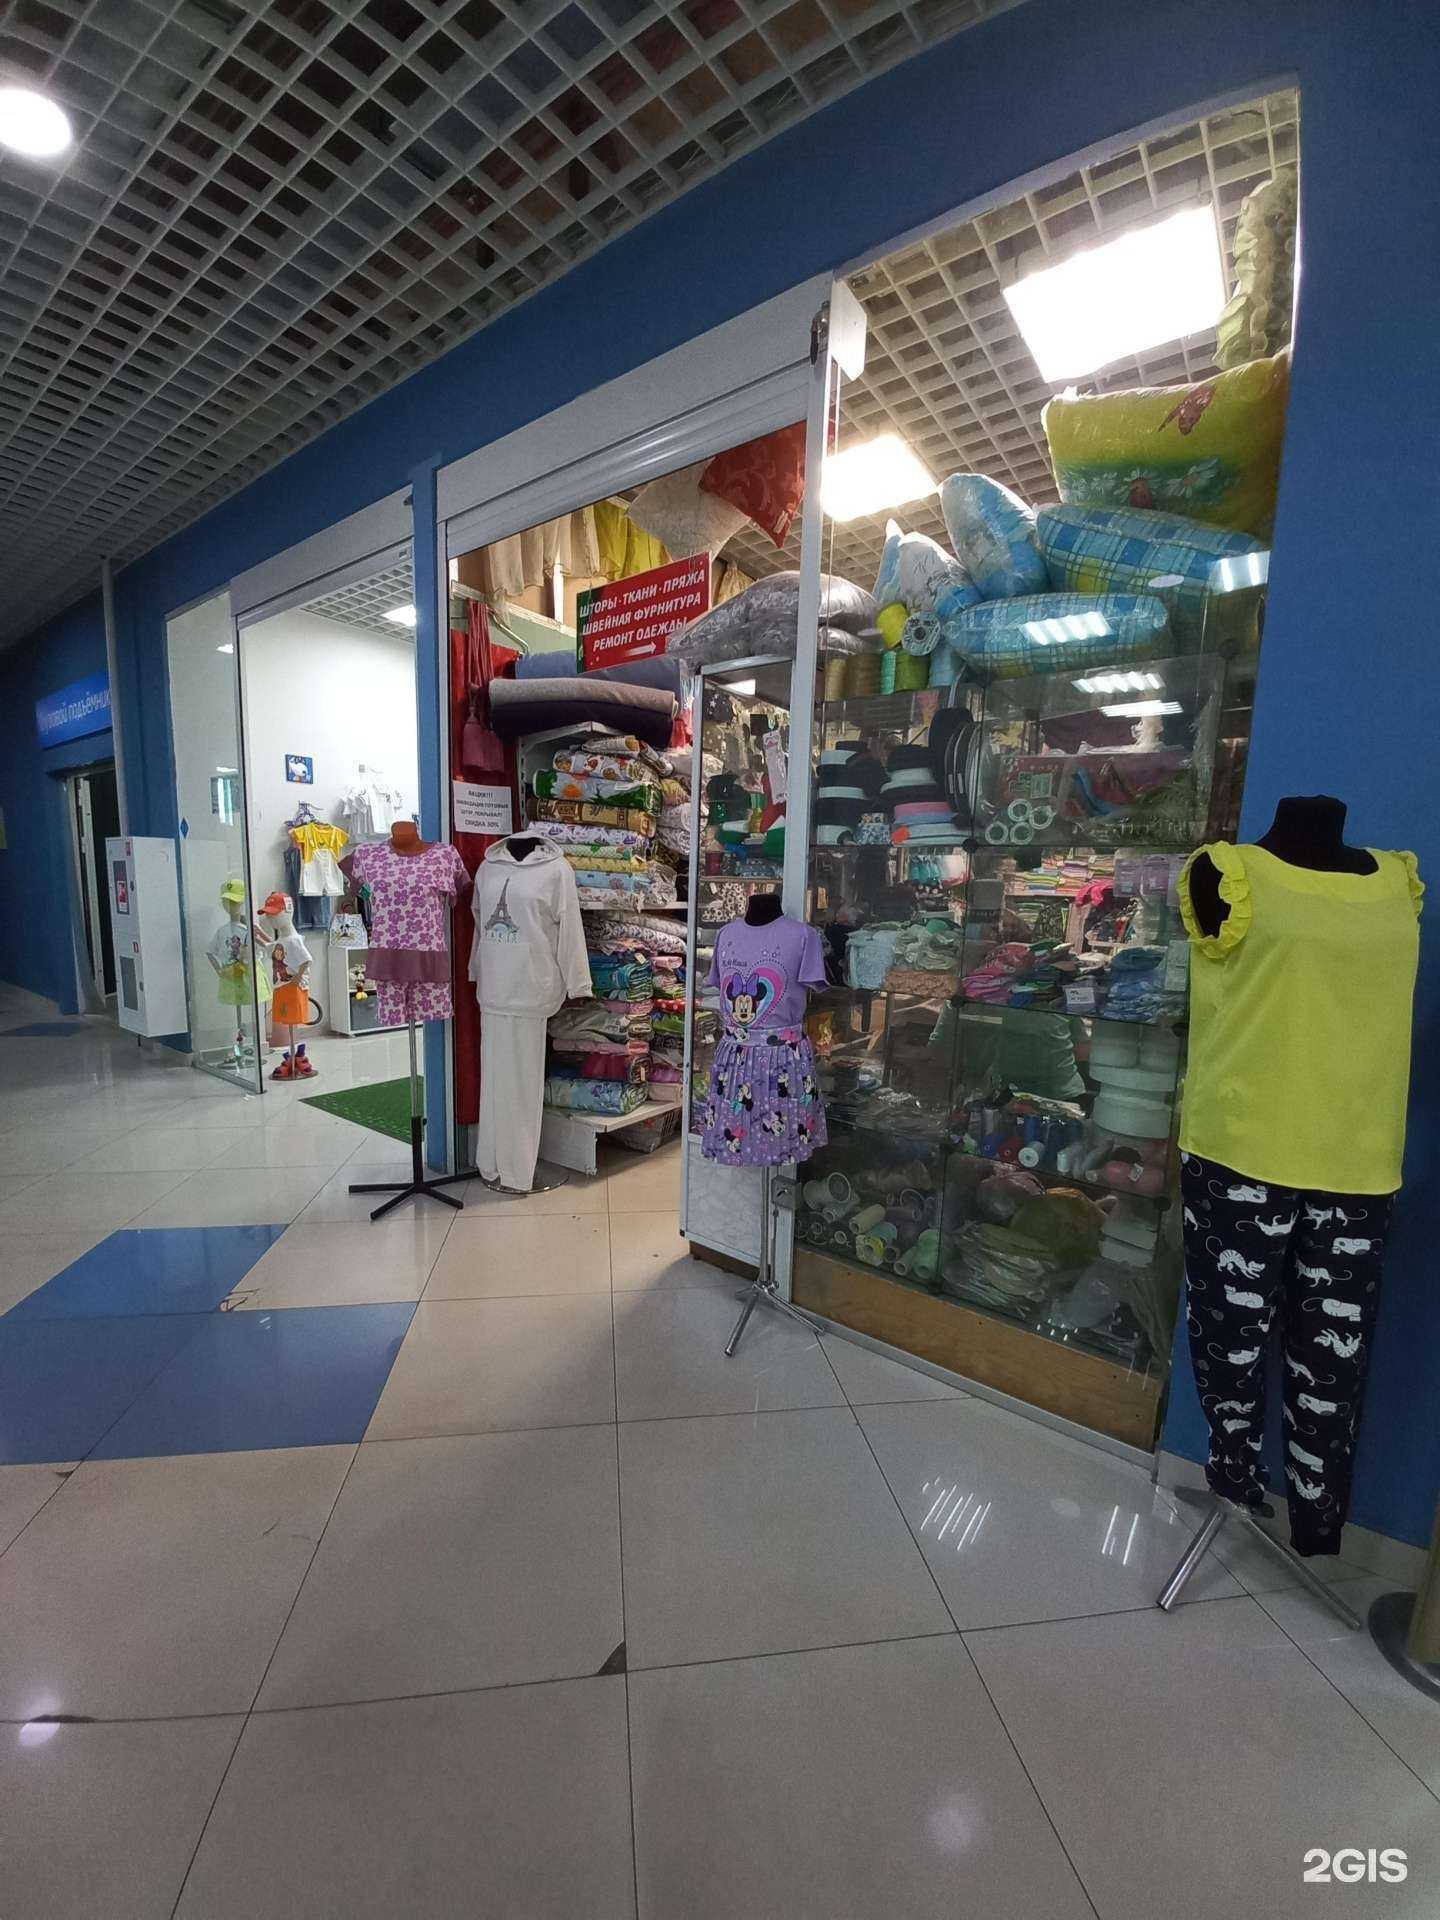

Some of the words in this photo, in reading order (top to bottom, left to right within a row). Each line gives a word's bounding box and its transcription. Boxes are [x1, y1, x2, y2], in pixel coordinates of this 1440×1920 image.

[580, 596, 618, 617] ШТОРЫ
[622, 585, 658, 604] ТКАНИ
[662, 569, 705, 593] ПРЯЖА
[582, 612, 632, 635] ШВЕЙНАЯ
[633, 592, 701, 621] ФУРНИТУРА
[593, 631, 634, 652] РЕМОНТ
[636, 617, 688, 640] ОДЕЖДЫ
